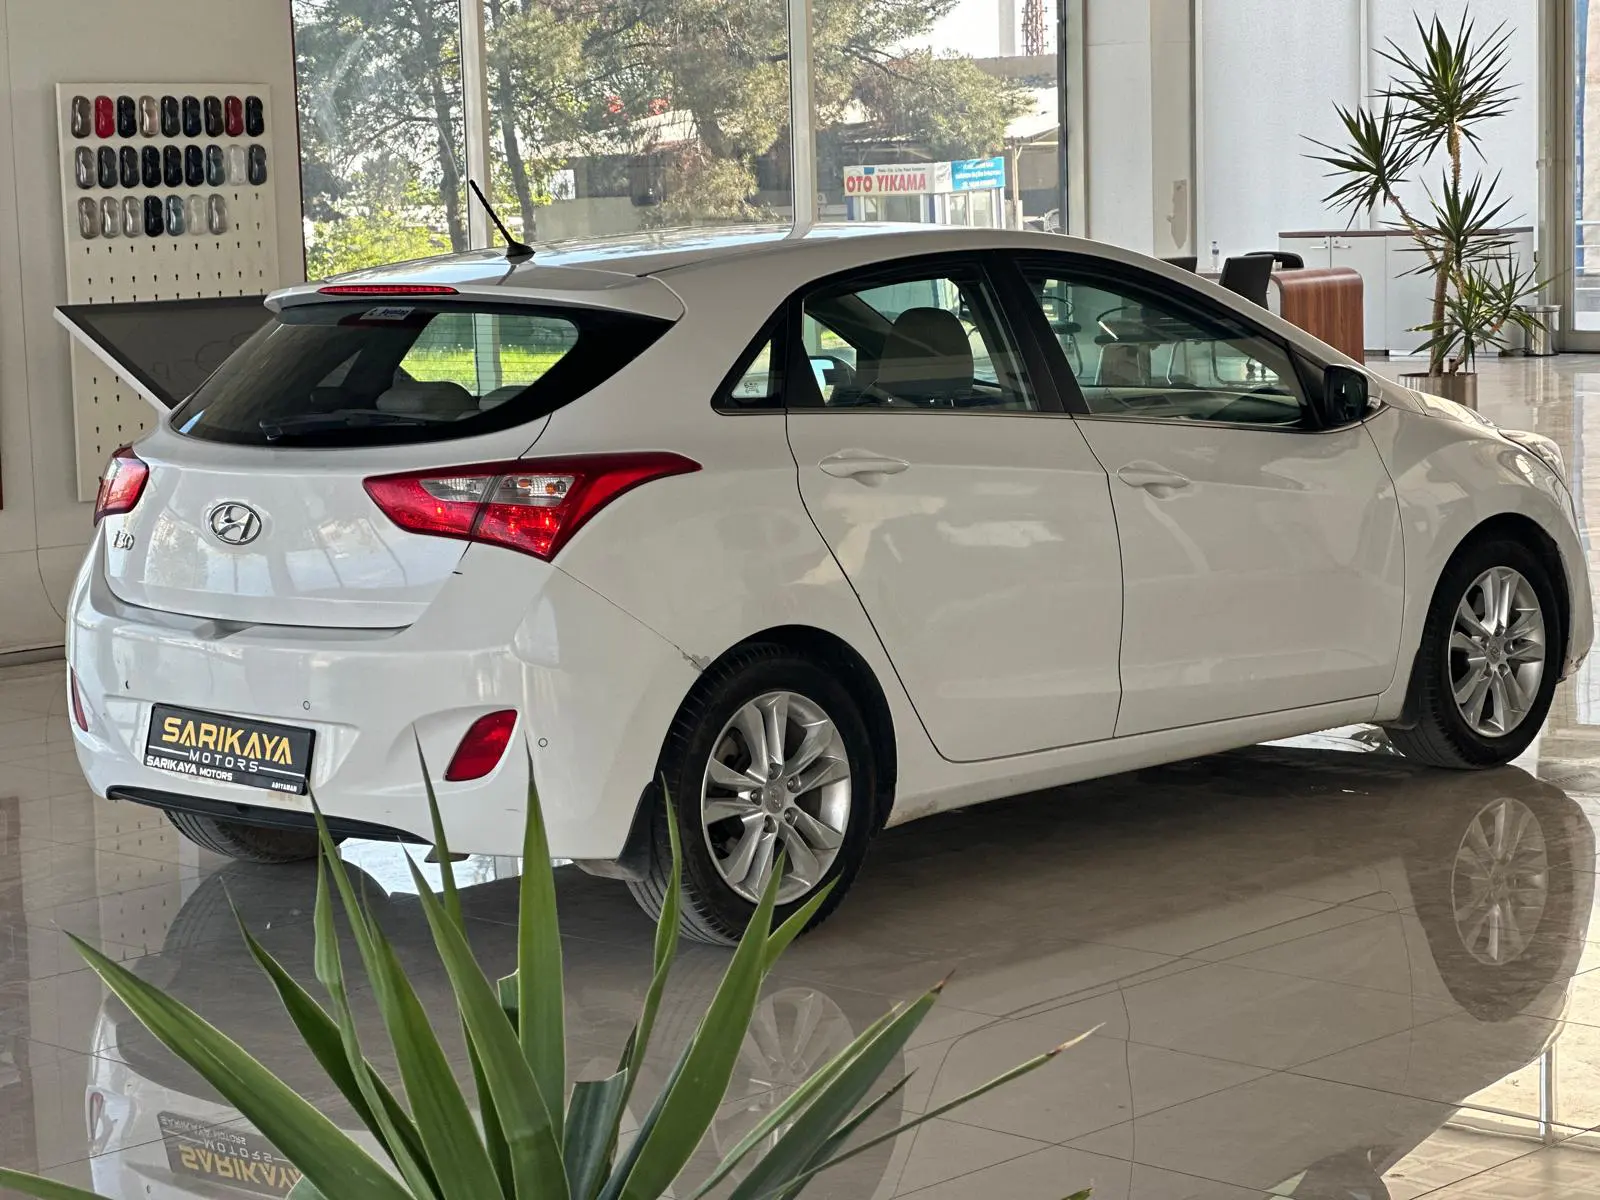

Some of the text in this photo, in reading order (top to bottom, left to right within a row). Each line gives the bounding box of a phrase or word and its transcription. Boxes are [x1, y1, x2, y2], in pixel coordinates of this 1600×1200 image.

[846, 175, 872, 193] OTO
[877, 173, 927, 192] YIKAMA
[162, 716, 292, 765] SARIKAYA
[146, 756, 233, 781] SARIKAYA MOTORS
[189, 749, 259, 772] MOTORS
